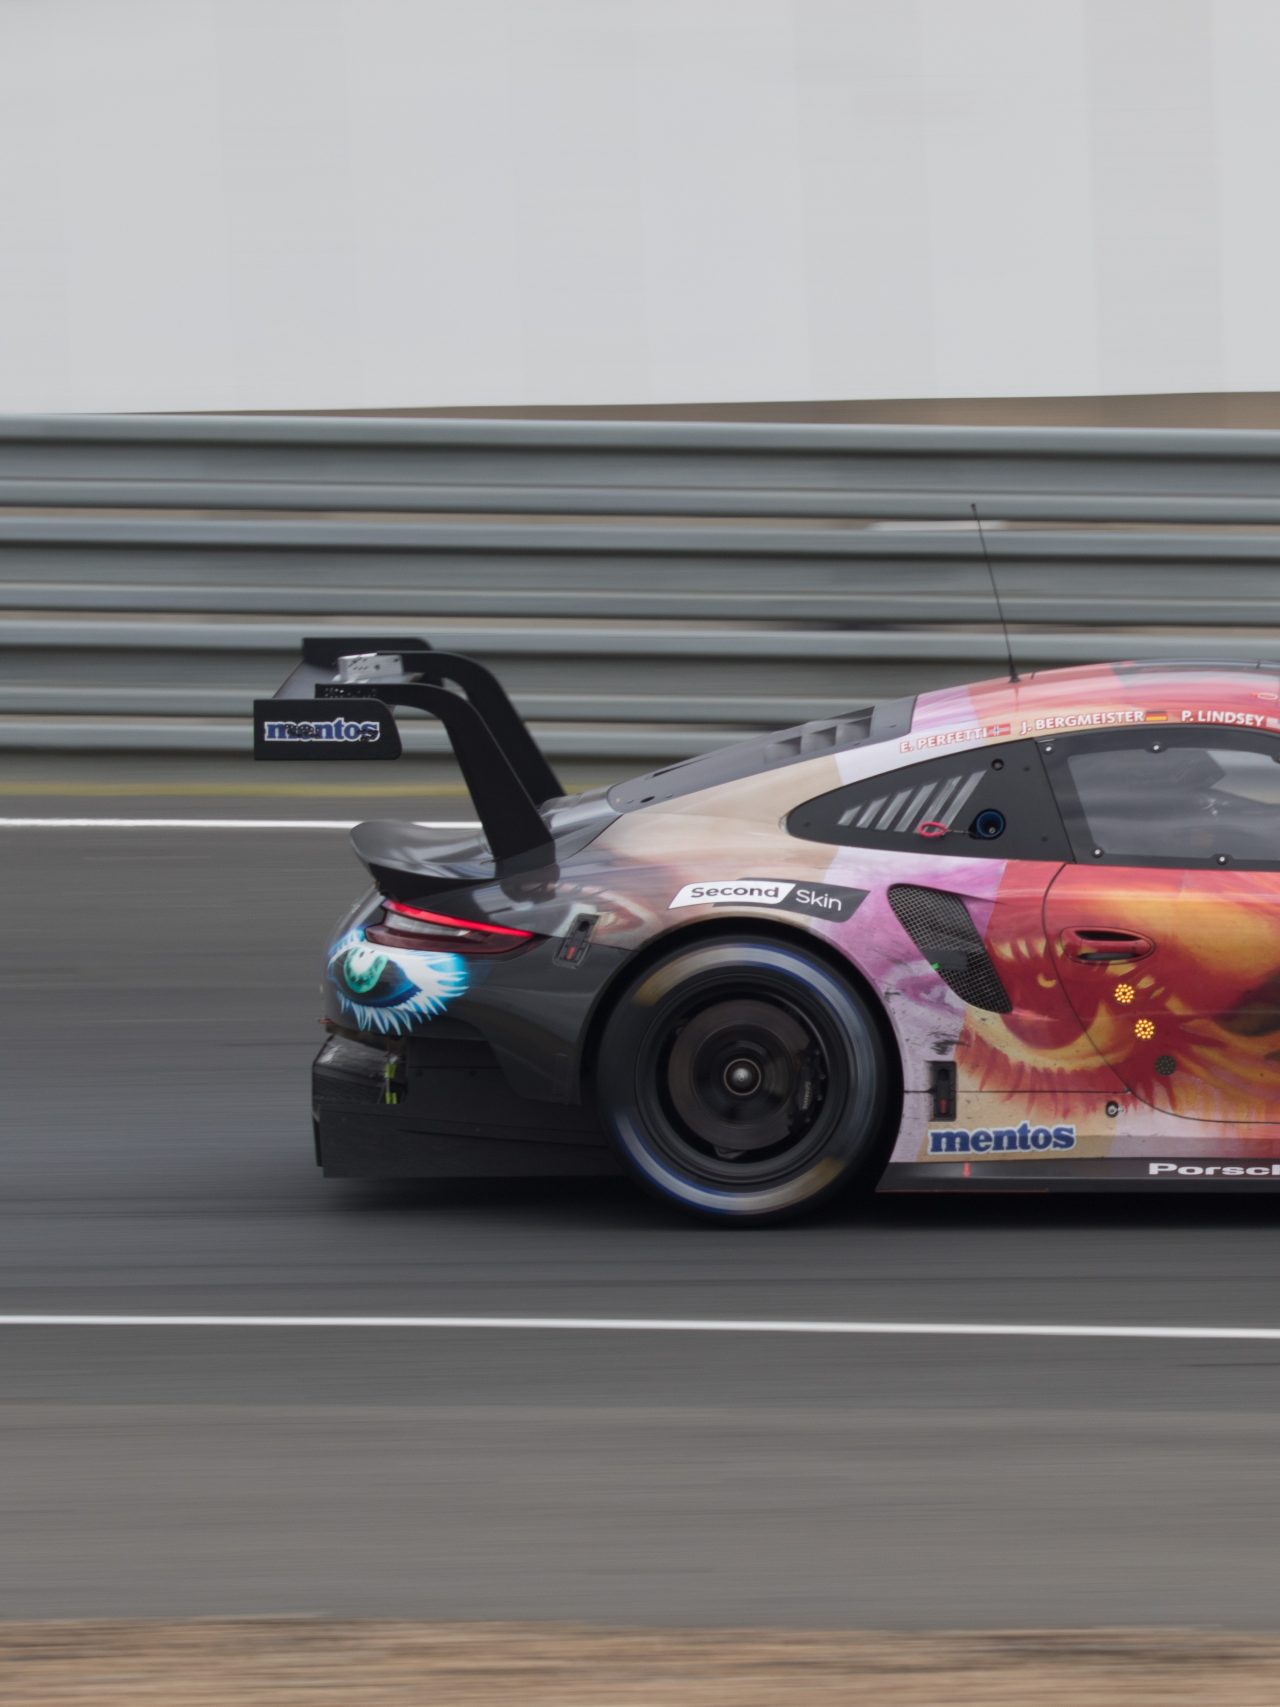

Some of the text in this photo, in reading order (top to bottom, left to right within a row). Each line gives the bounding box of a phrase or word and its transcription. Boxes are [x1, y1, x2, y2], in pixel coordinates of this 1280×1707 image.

[264, 717, 380, 742] mentos
[1020, 711, 1146, 736] J. BERGMEISTER
[1181, 709, 1265, 727] P. LINDSEY
[900, 727, 988, 754] E. PERFETTI
[690, 886, 843, 912] Second Skin
[929, 1121, 1076, 1154] mentos
